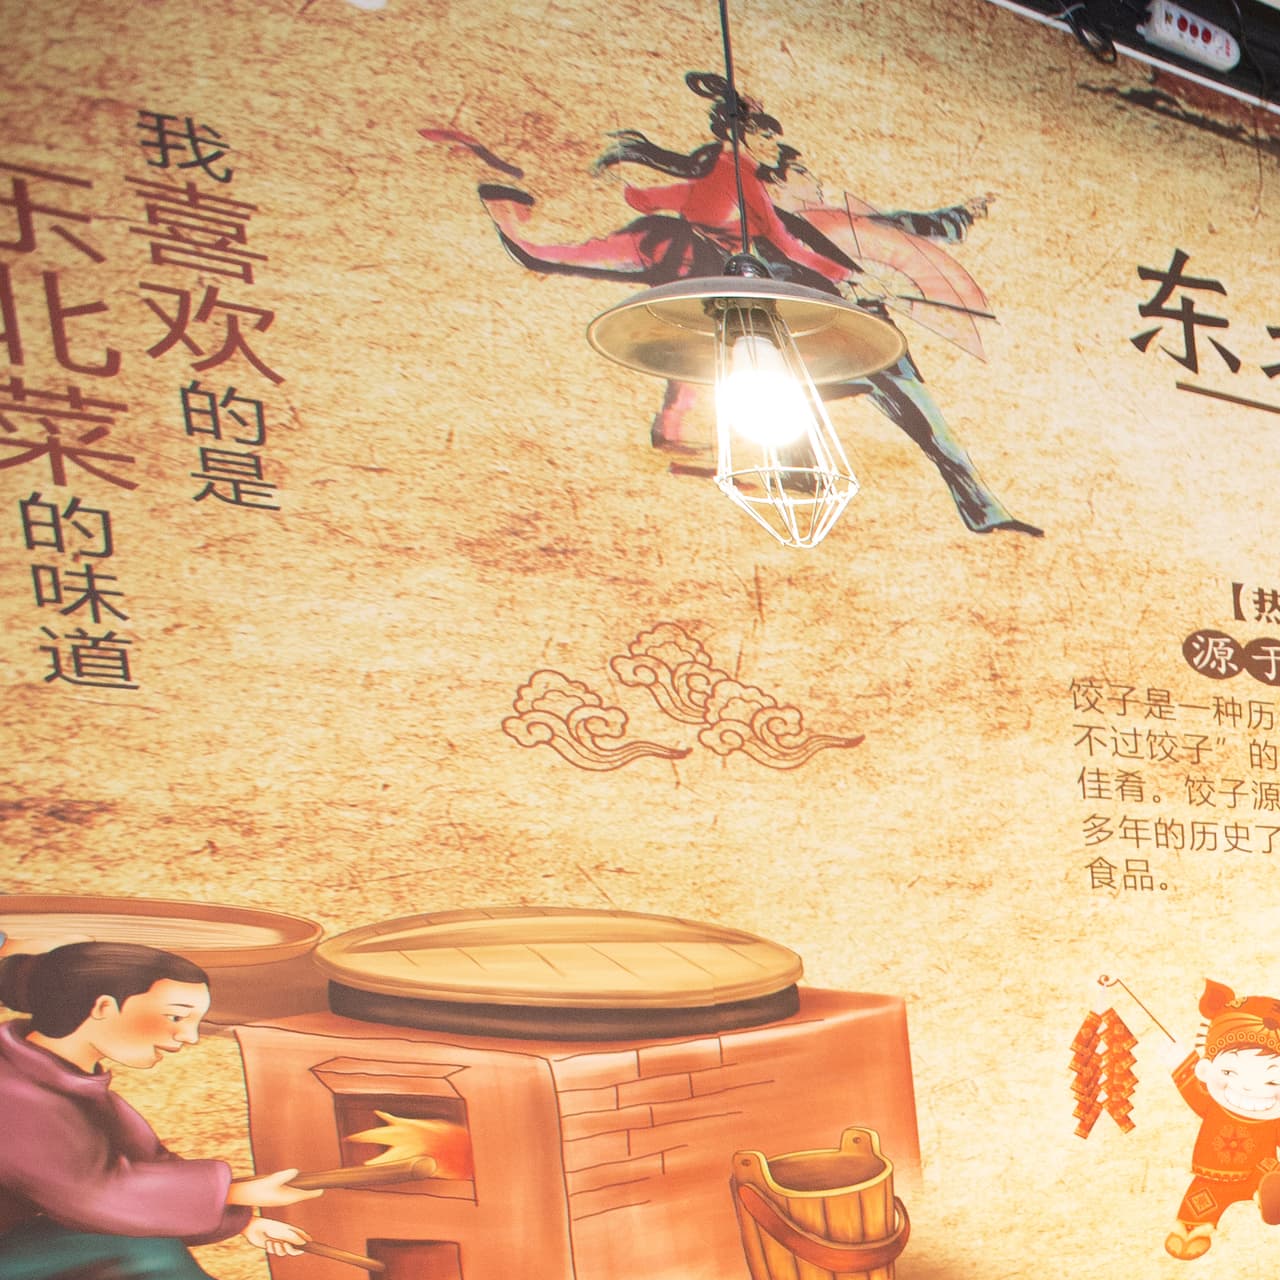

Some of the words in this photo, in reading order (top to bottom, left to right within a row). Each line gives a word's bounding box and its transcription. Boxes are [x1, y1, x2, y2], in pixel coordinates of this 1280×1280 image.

[124, 109, 285, 512] 我喜欢的是
[1085, 856, 1169, 892] 食品。
